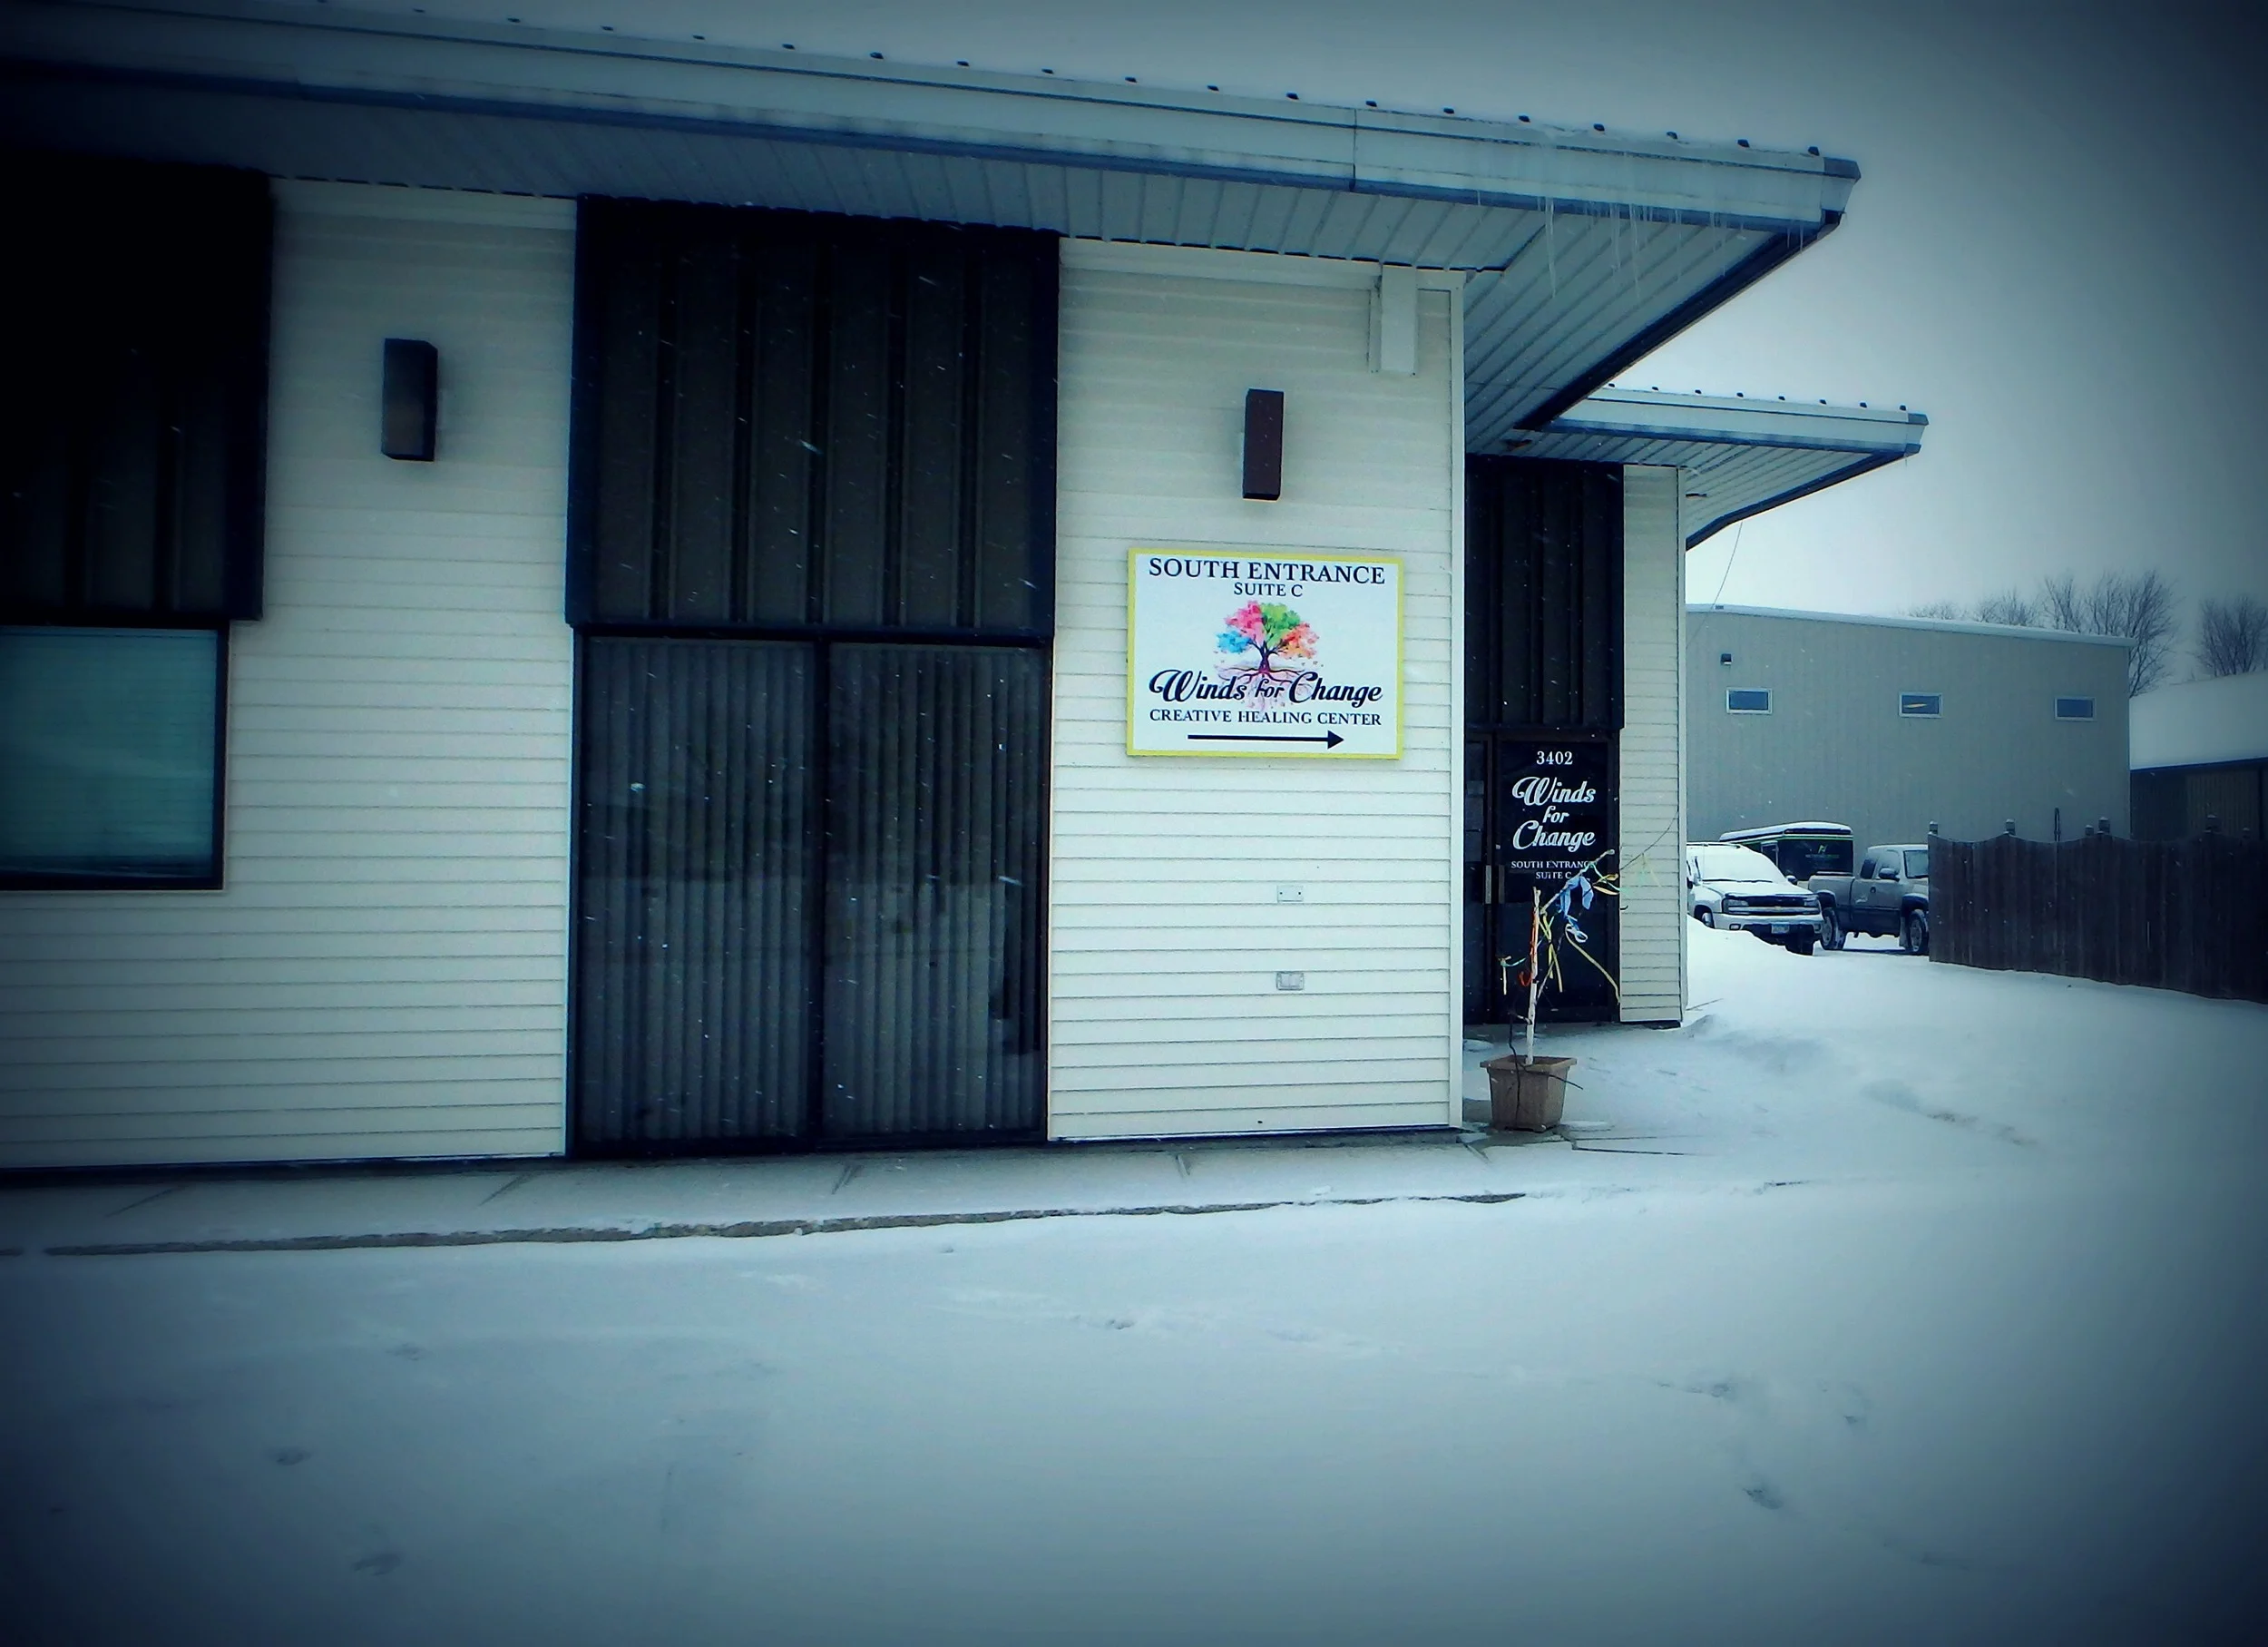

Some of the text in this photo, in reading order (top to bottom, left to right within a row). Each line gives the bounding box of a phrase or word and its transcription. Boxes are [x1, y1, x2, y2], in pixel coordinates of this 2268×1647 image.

[1149, 557, 1385, 584] SOUTH ENTRANCE
[1233, 582, 1304, 597] SUITE C
[1149, 669, 1383, 708] Winds for Change
[1149, 709, 1382, 725] CREATIVE HEALING CENTER
[1536, 750, 1573, 765] 3402
[1511, 776, 1597, 806] Winds
[1542, 805, 1569, 823] for
[1512, 820, 1596, 853] Change
[1510, 860, 1544, 868] SOUTH
[1536, 871, 1572, 879] SUITE C
